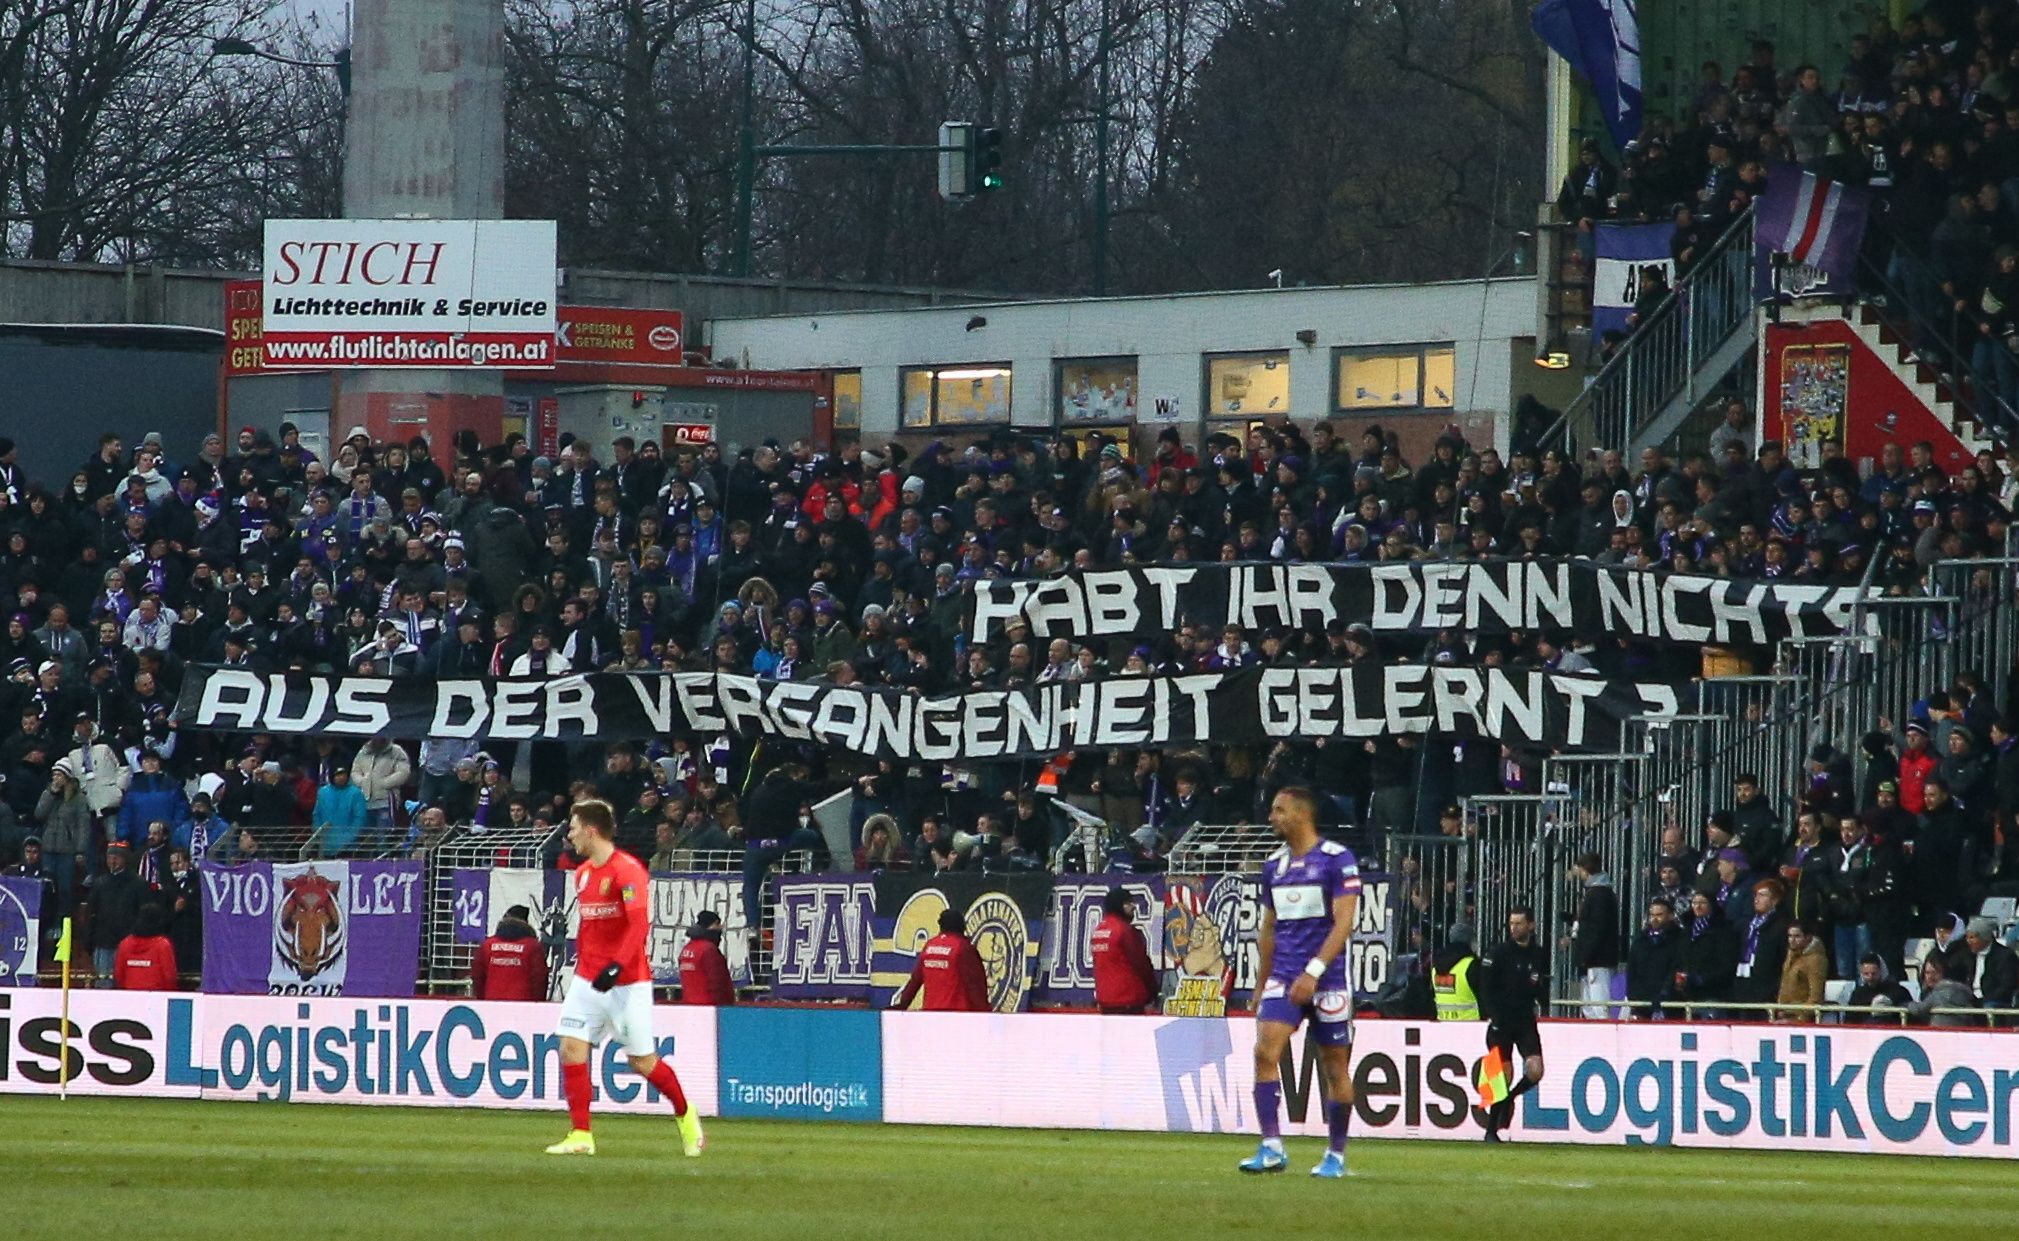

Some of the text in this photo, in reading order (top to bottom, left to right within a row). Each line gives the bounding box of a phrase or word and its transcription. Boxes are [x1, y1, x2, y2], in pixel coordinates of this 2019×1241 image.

[272, 240, 447, 286] STICH
[272, 298, 547, 317] Lichttechnik & Service
[574, 322, 635, 336] SPEISEN &
[266, 336, 548, 364] www.flutlichtanlagen.at
[972, 567, 1198, 643] HABT
[1227, 565, 1338, 629] IHR
[1372, 561, 1573, 629] DENN
[196, 669, 393, 734] AUS
[428, 674, 598, 739] DER
[626, 671, 1224, 760] VERGANGENHEIT
[1258, 664, 1608, 746] GELERNT
[14, 936, 27, 952] 12
[164, 998, 675, 1103] LogistikCener
[727, 1077, 868, 1113] Transportlogistik
